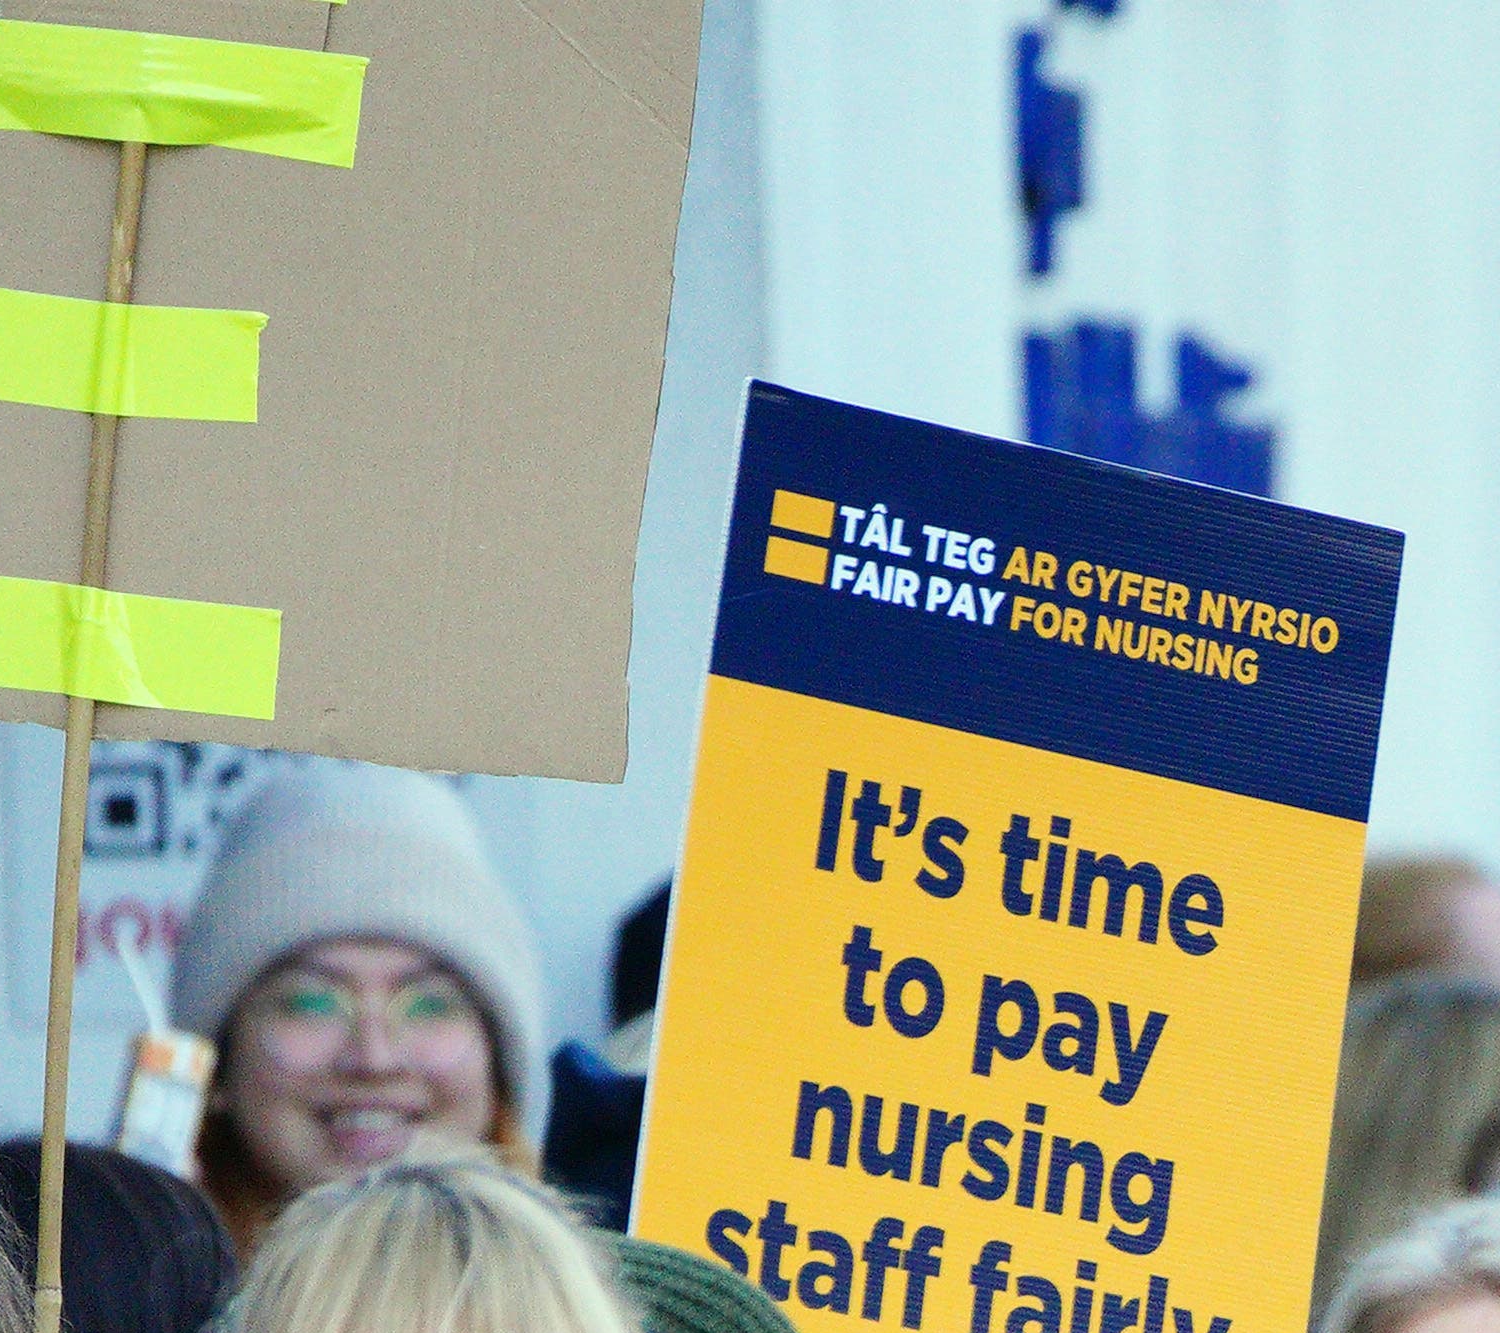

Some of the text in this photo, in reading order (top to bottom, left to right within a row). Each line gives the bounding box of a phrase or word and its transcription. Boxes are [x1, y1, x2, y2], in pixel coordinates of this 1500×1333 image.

[831, 554, 1258, 685] FAIR PAY FOR NURSING
[840, 503, 1339, 653] TÂL TEG AR GYFER NYRSIO
[1000, 814, 1224, 956] time
[842, 925, 1168, 1106] to pay
[792, 1080, 1174, 1256] nursing
[704, 1200, 944, 1330] staff
